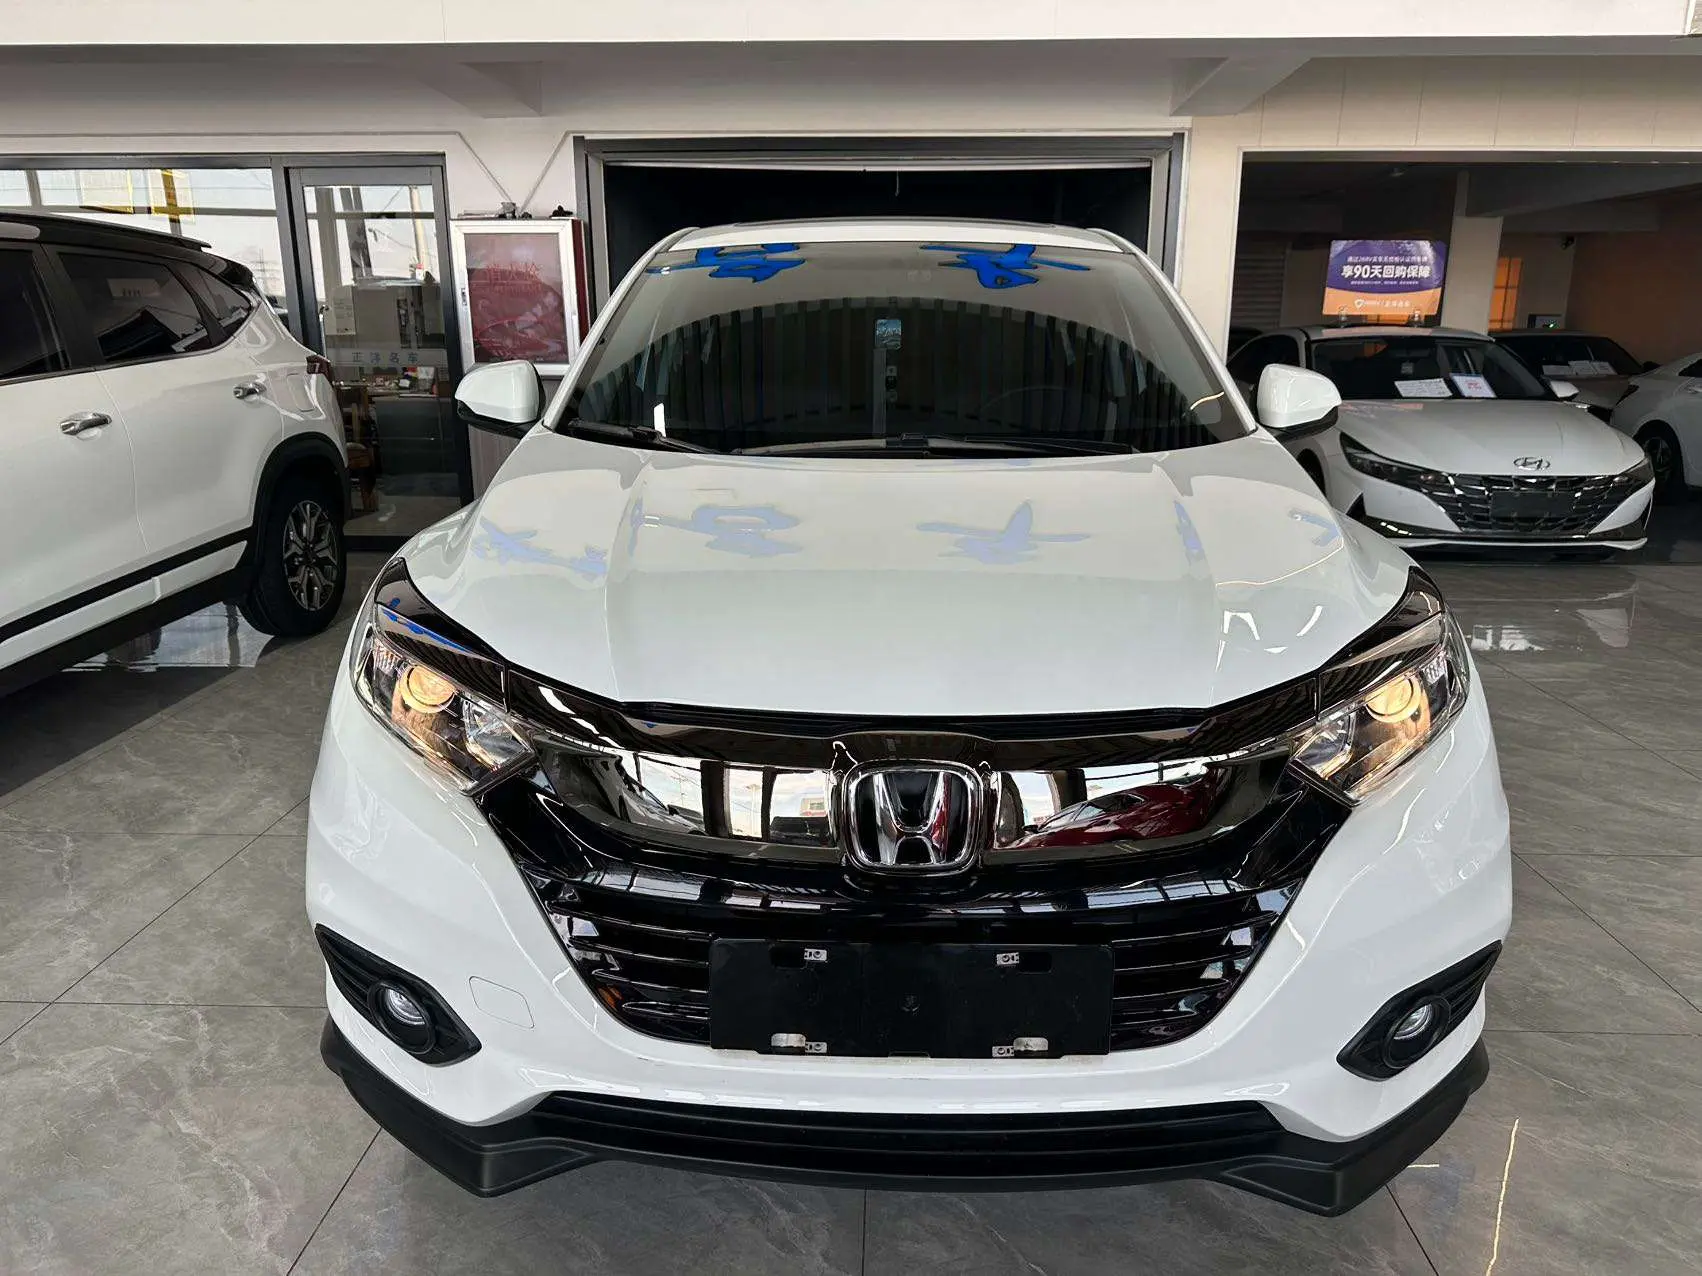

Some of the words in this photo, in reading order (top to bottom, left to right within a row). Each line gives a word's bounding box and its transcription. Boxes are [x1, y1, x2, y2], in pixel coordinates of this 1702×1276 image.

[1341, 264, 1431, 279] 享90天回购保障
